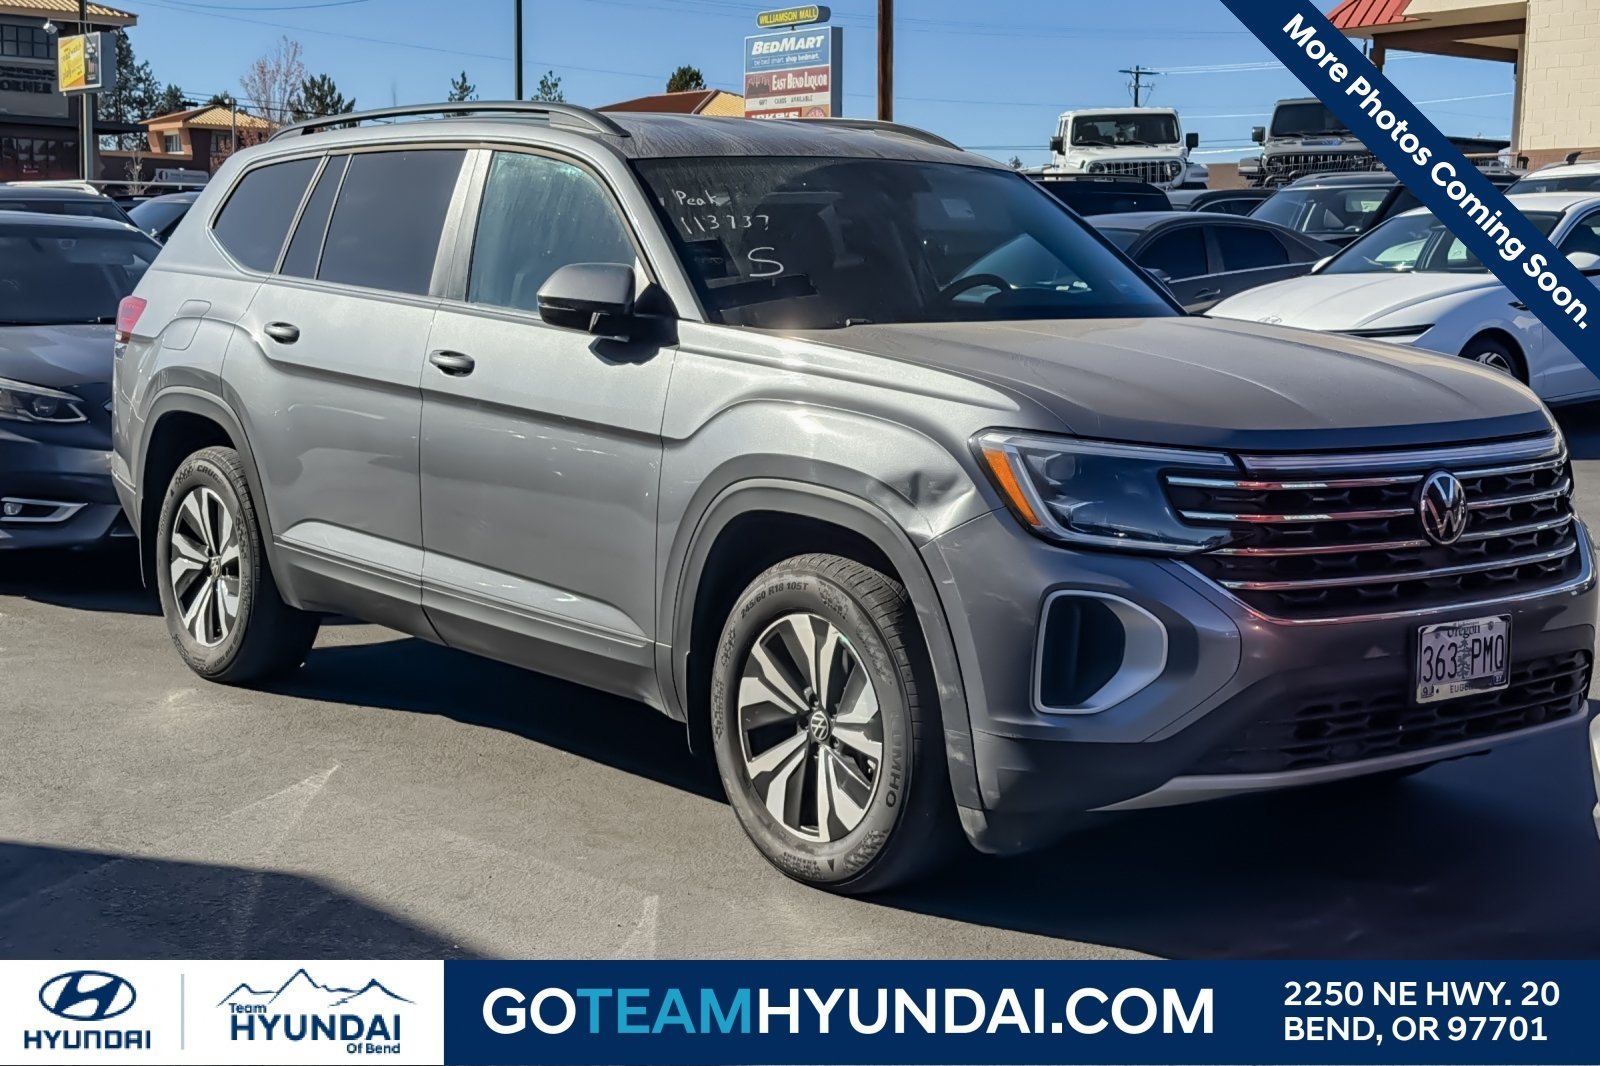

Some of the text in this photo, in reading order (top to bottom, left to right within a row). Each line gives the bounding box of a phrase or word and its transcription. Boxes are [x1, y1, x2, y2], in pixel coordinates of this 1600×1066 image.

[759, 8, 817, 25] WILLIAMSON MALL
[772, 71, 828, 91] EAST BEND LIQUOR
[747, 246, 784, 277] S
[768, 583, 784, 596] R18
[1422, 634, 1505, 682] 363 PMQ
